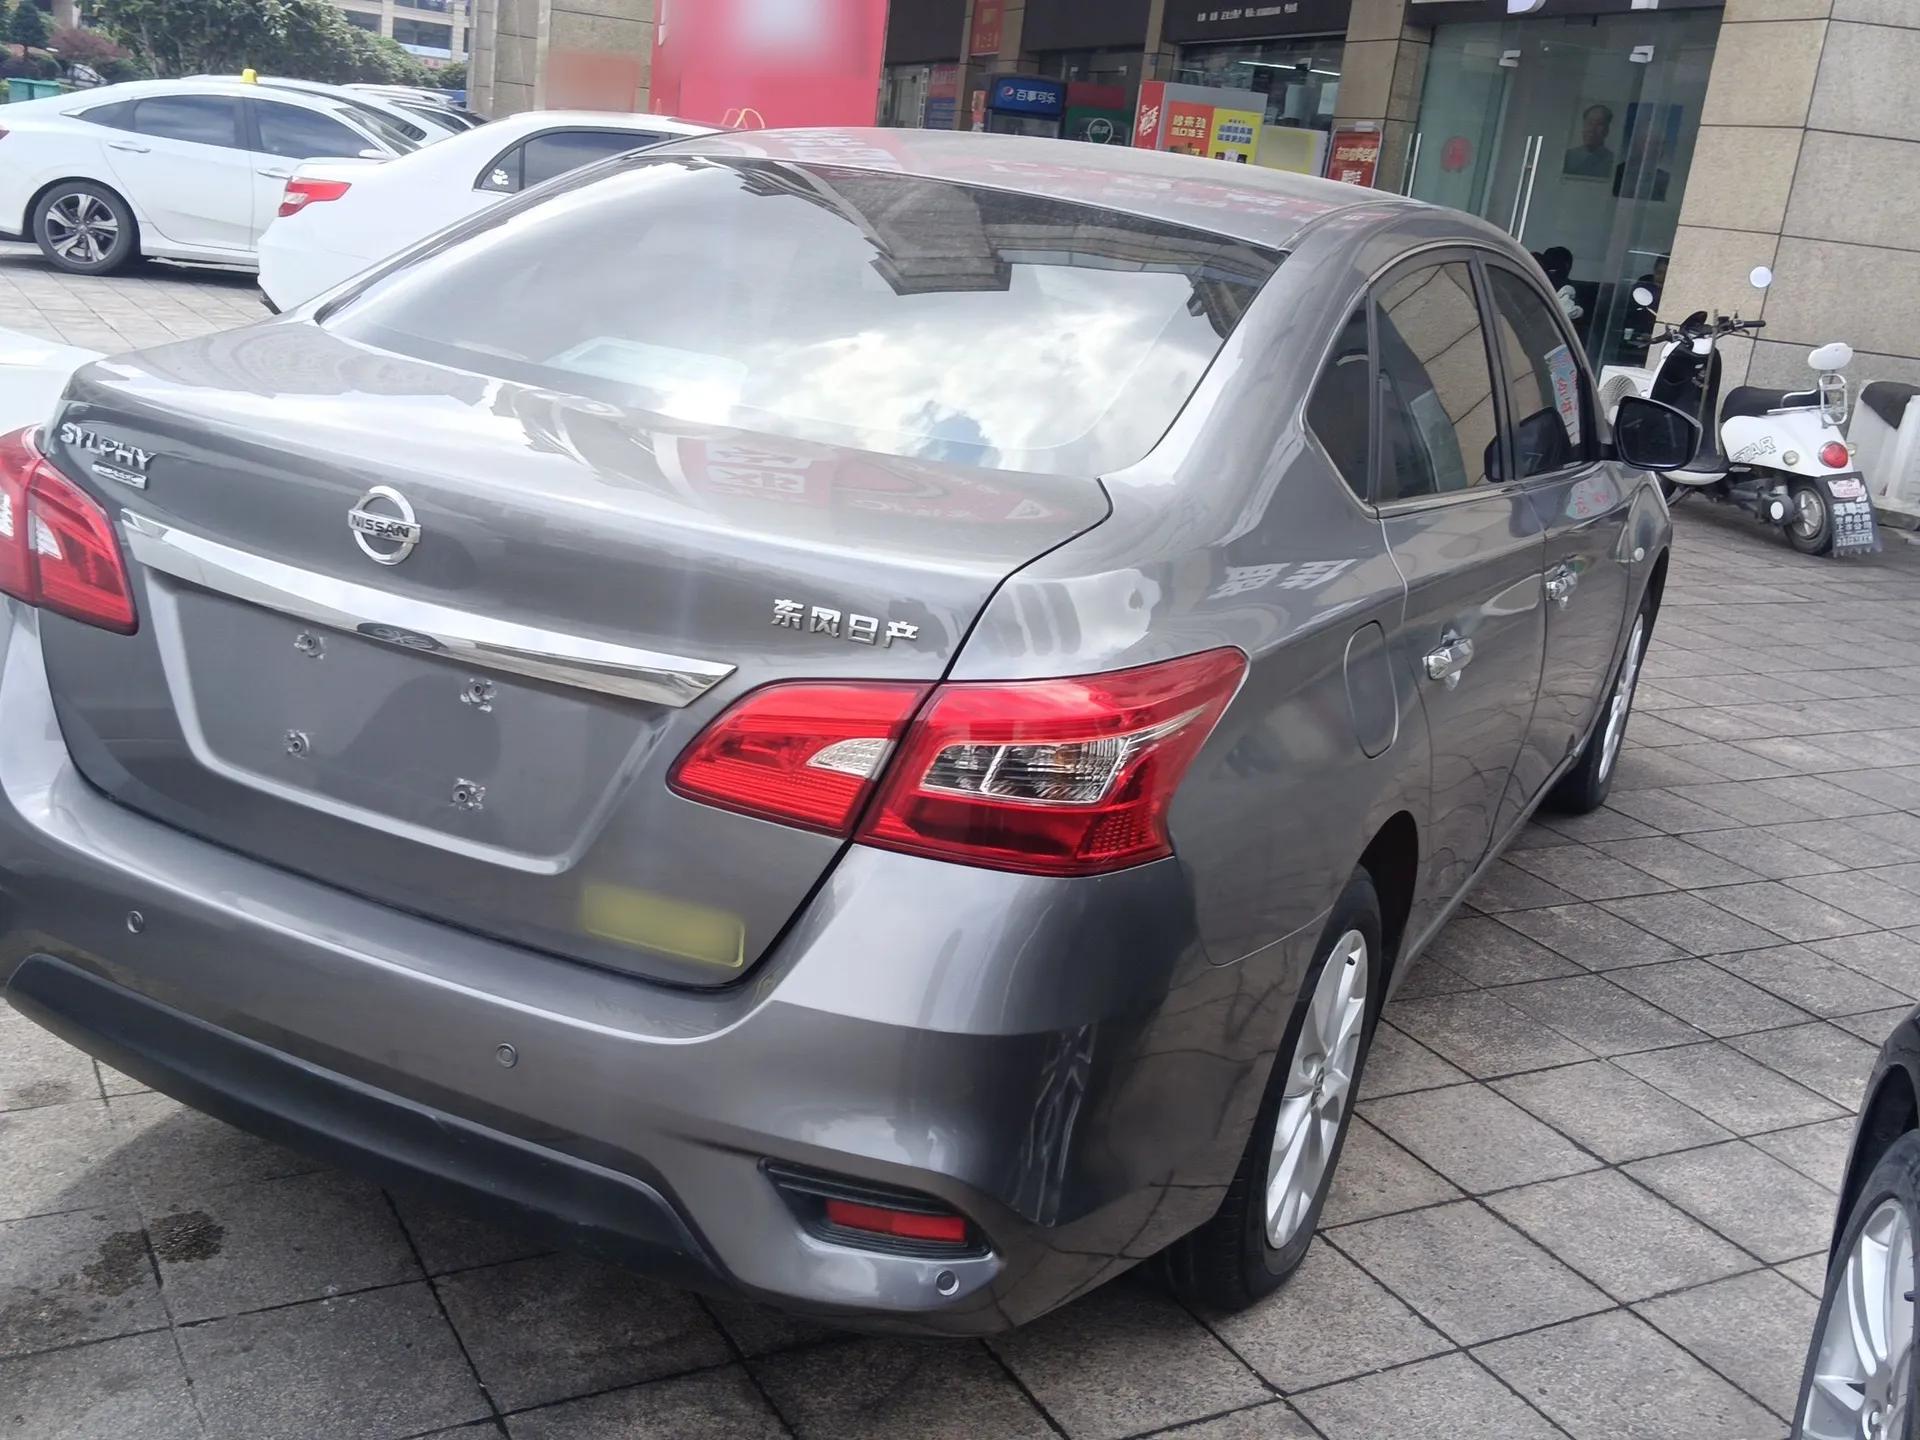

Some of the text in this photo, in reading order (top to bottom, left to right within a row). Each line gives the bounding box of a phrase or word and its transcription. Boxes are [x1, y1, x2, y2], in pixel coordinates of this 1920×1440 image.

[60, 422, 157, 470] SYLPHY
[351, 513, 411, 539] NISSAN
[770, 598, 919, 649] 东风日产
